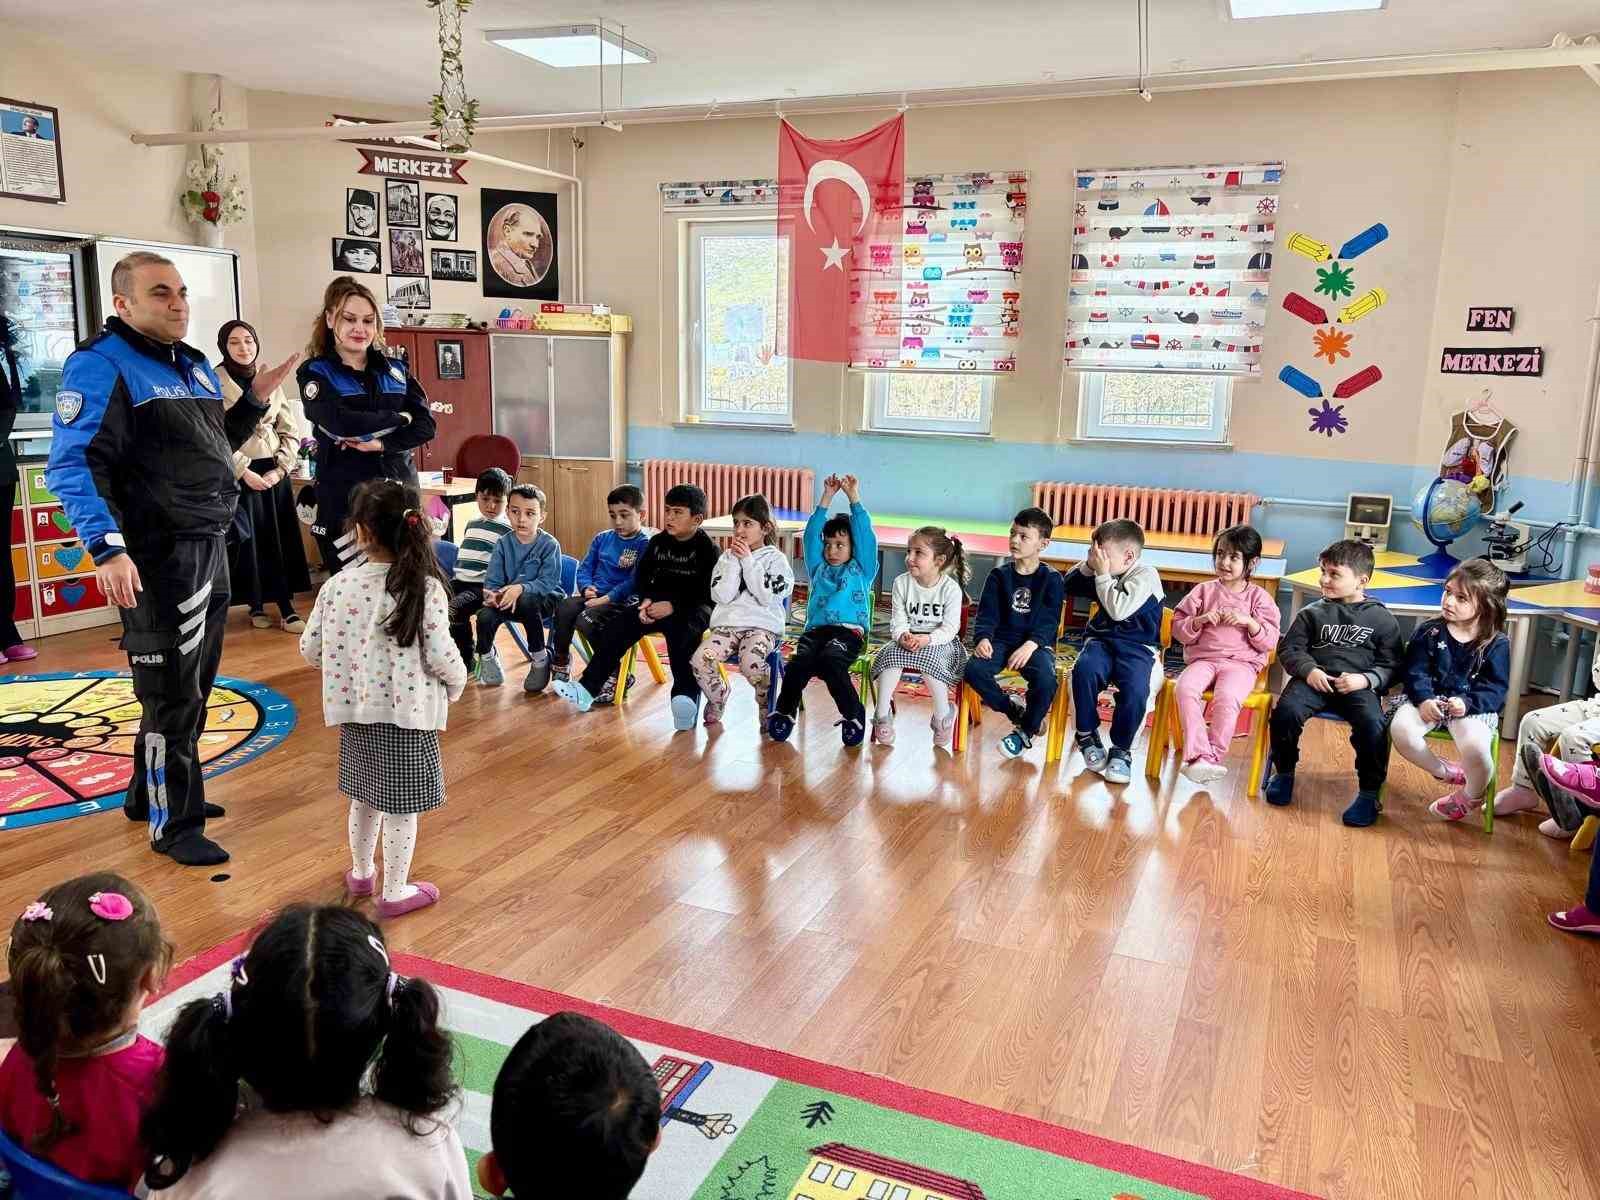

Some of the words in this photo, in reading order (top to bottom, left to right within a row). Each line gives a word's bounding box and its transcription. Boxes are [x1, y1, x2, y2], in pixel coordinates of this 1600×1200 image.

[374, 156, 453, 178] MERKEZİ
[1469, 309, 1512, 328] FEN
[1441, 348, 1541, 373] MERKEZİ
[131, 654, 164, 664] POLIS
